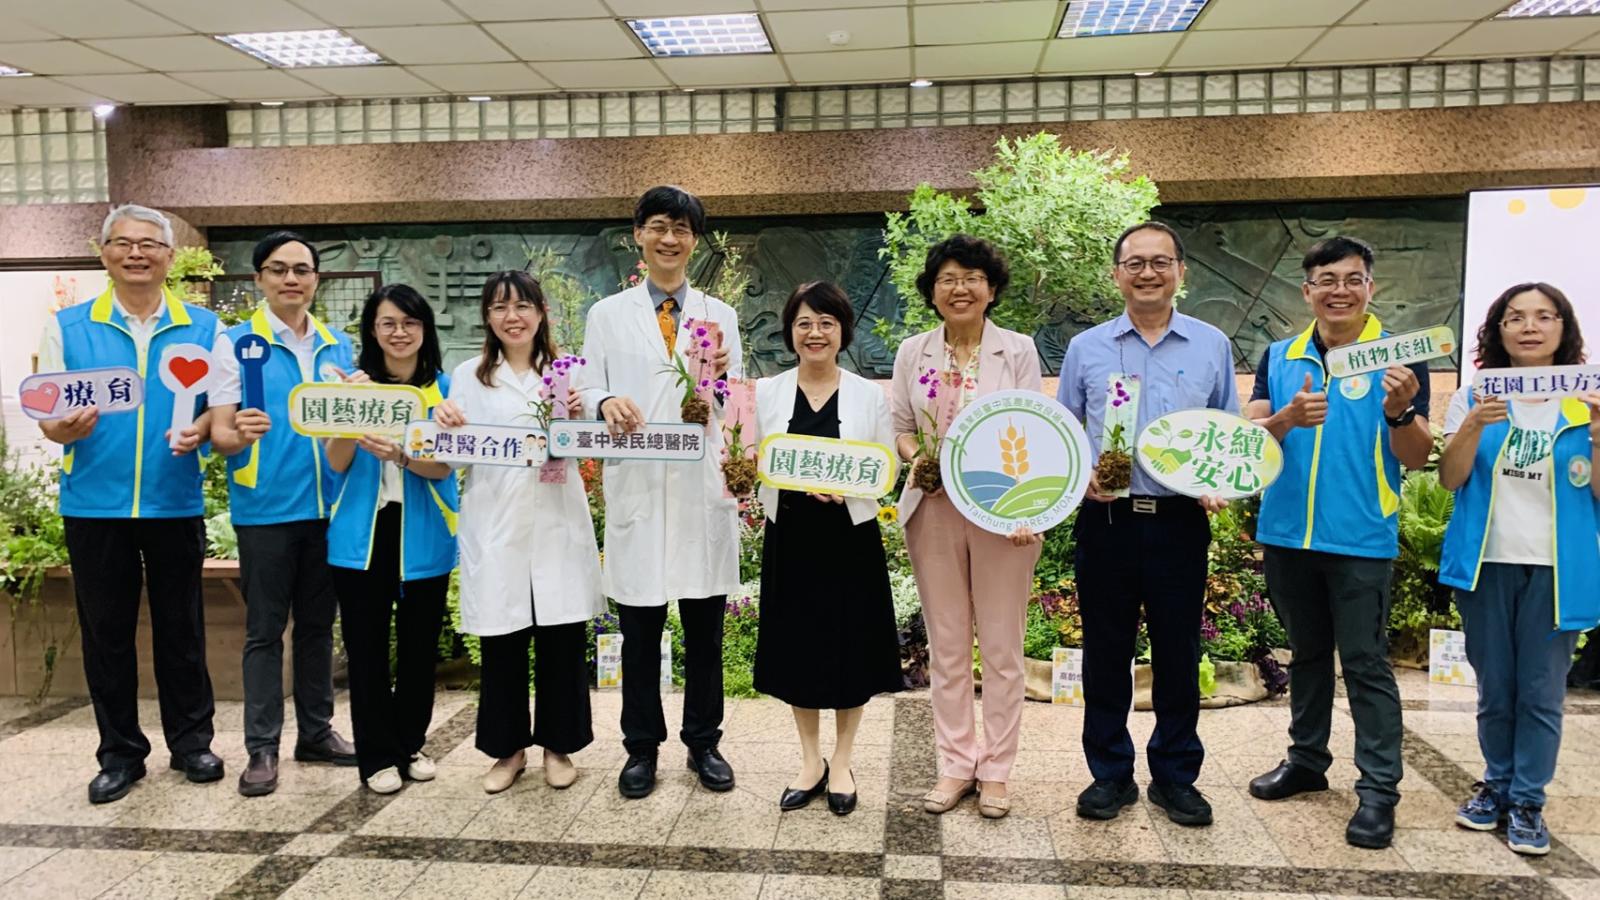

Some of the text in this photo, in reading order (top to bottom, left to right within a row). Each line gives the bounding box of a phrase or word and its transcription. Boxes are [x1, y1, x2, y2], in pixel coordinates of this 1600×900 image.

[1347, 336, 1434, 370] 植物套組
[63, 377, 132, 408] 療育
[301, 396, 414, 424] 園藝療育
[433, 432, 523, 459] 農醫合作
[576, 430, 699, 451] 臺中榮民總醫院
[1195, 421, 1265, 460] 永續
[769, 446, 882, 485] 園藝療育
[1192, 456, 1261, 492] 安心
[1502, 468, 1525, 478] MISS
[967, 504, 1013, 532] Taichung
[1054, 495, 1073, 515] MOA
